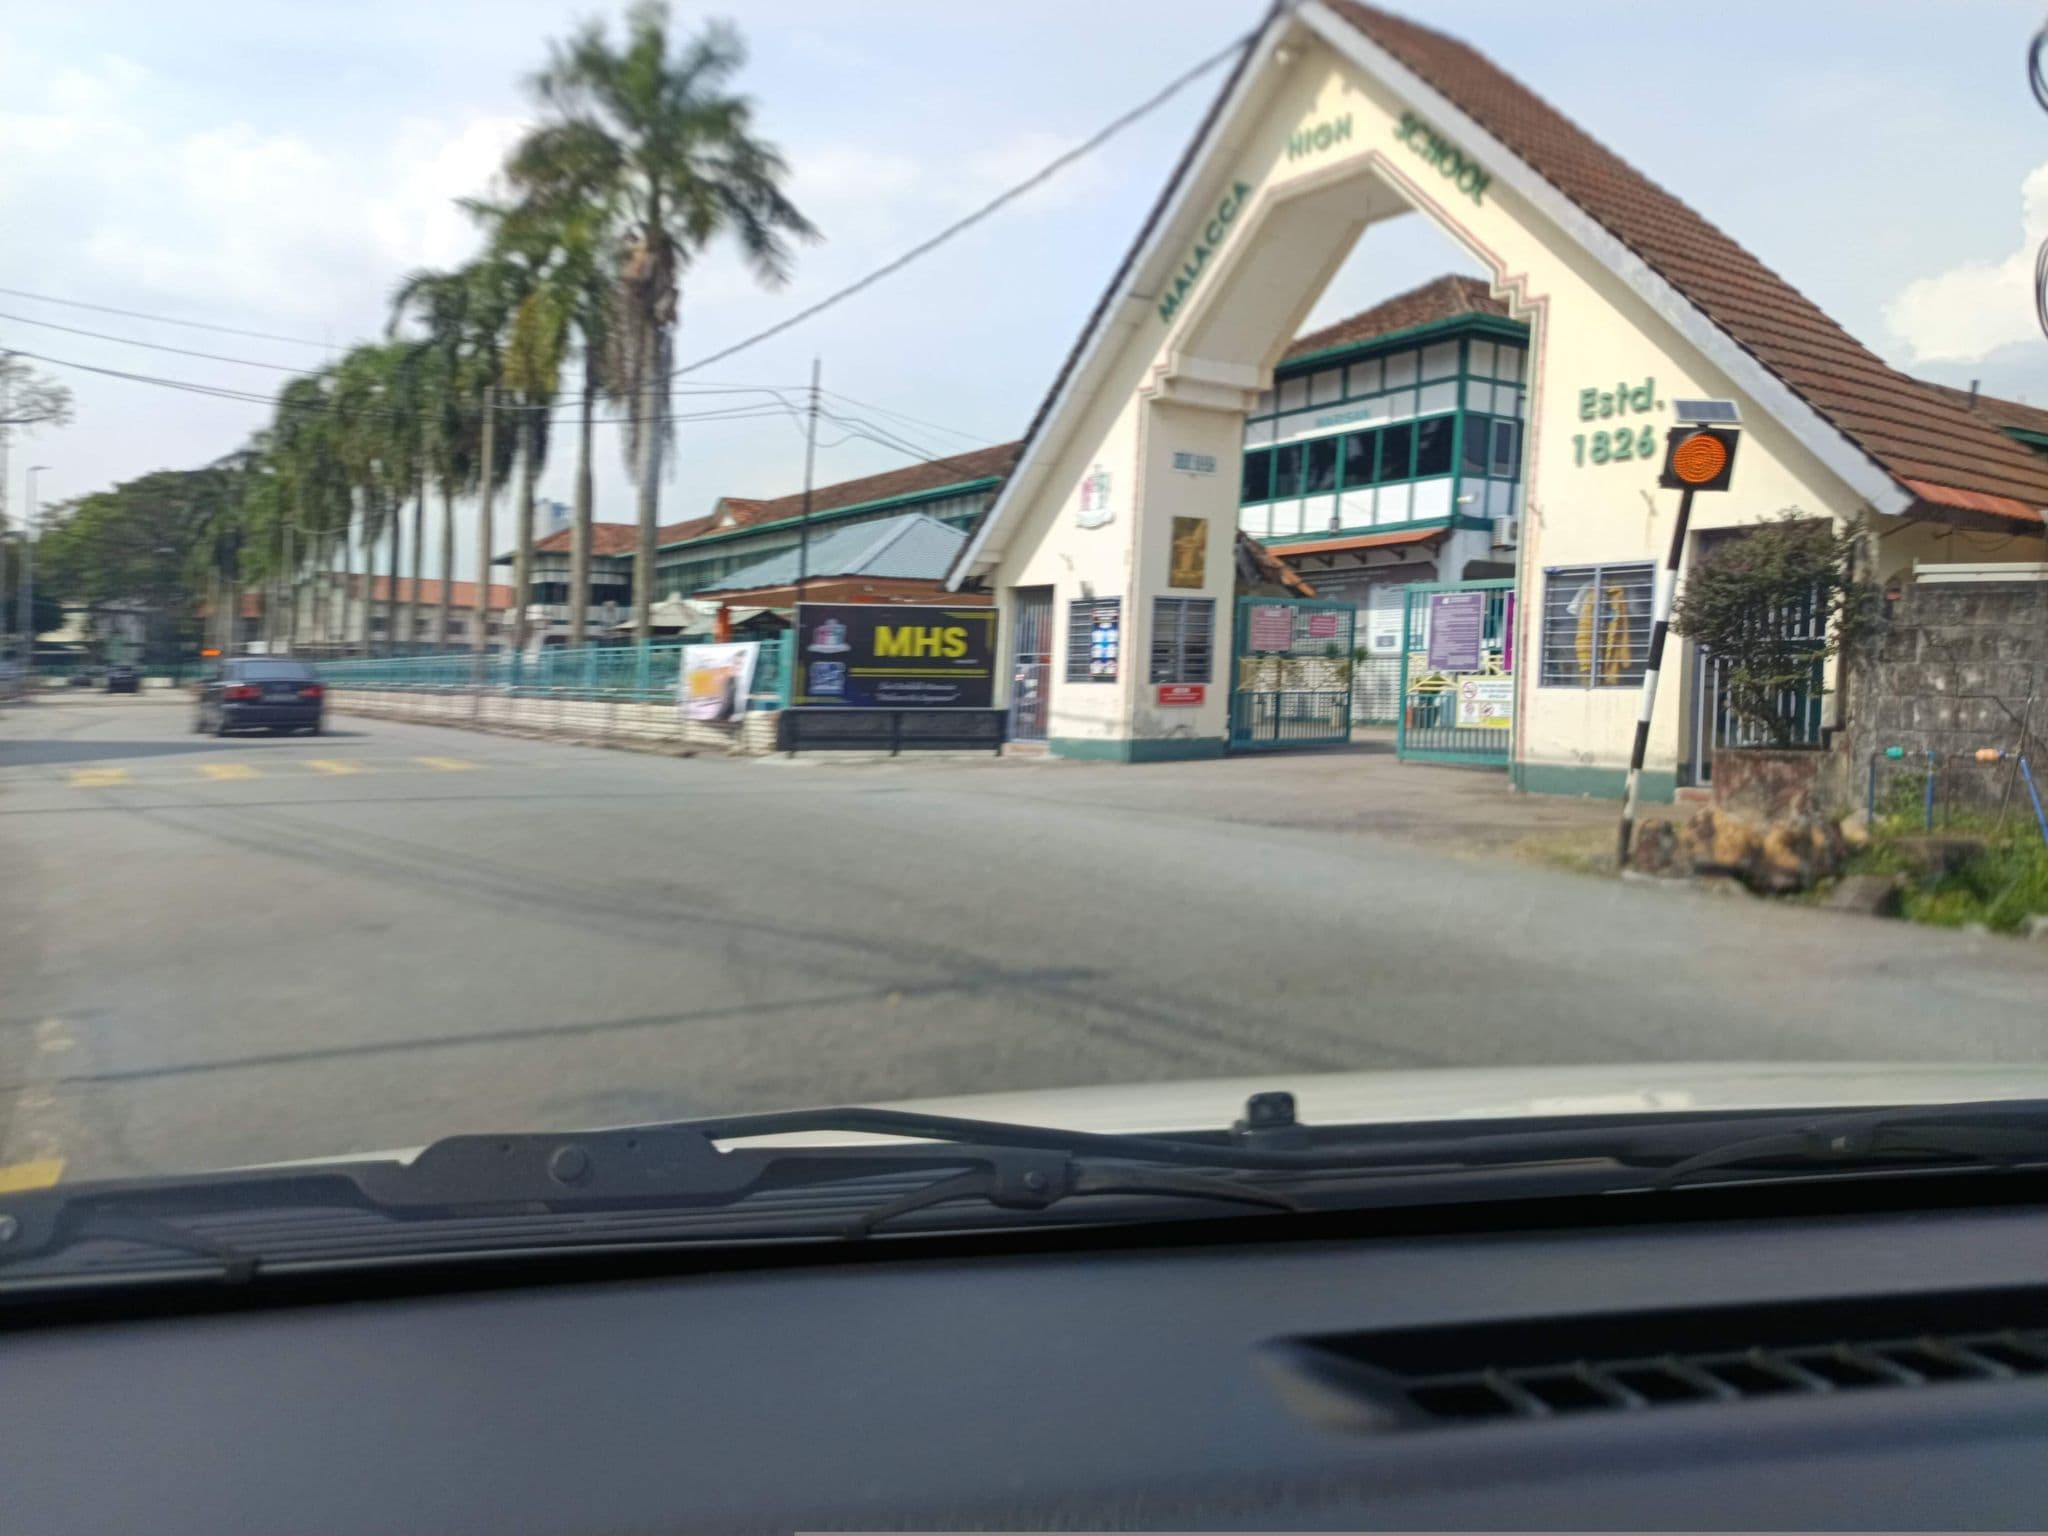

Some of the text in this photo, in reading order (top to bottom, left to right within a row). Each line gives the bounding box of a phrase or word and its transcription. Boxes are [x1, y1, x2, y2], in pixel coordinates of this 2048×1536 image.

[1157, 111, 1491, 325] MALACCA HIGH SCHOOL
[1579, 376, 1665, 422] Estd.
[1572, 425, 1656, 468] 1826
[873, 626, 969, 659] MHS
